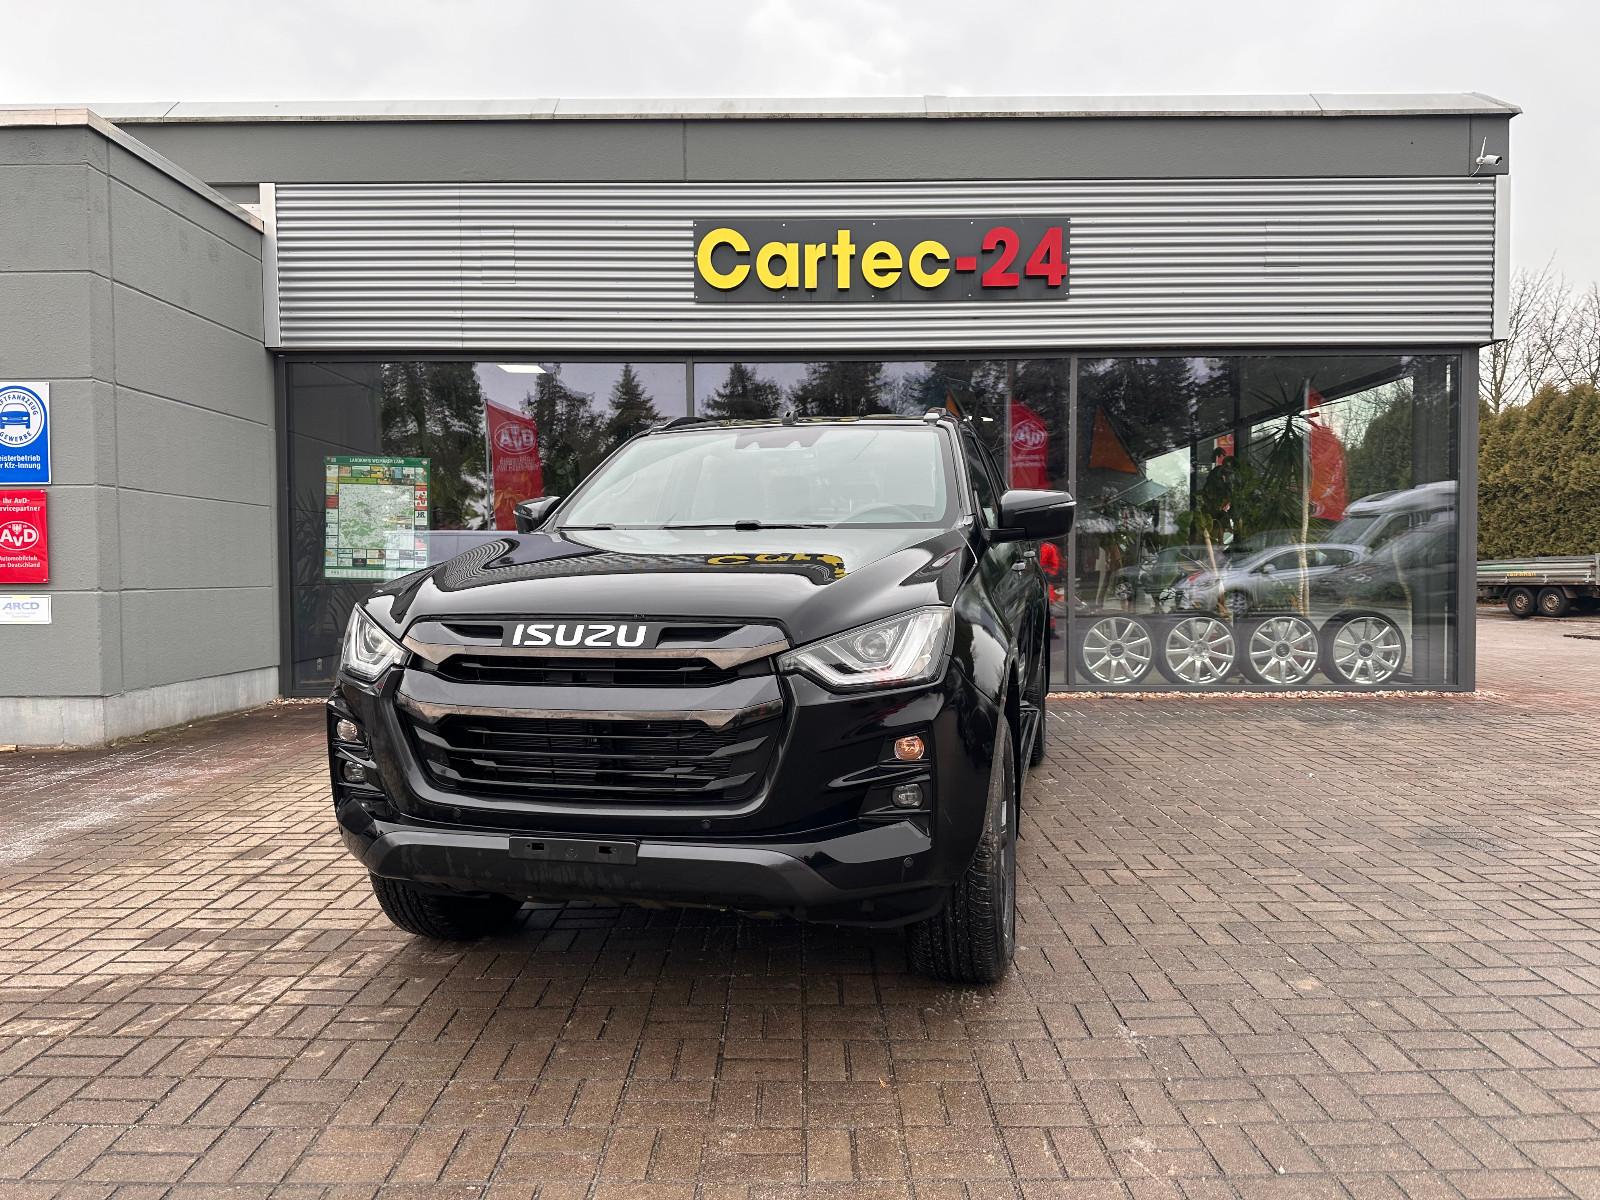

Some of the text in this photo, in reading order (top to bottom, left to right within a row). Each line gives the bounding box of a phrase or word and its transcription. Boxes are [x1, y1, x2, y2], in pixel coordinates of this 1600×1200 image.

[696, 226, 1067, 290] Cartec-24
[4, 462, 41, 471] Kfz-Innung
[0, 528, 37, 547] AvD
[3, 602, 40, 610] ARCD
[511, 624, 647, 648] ISUZU
